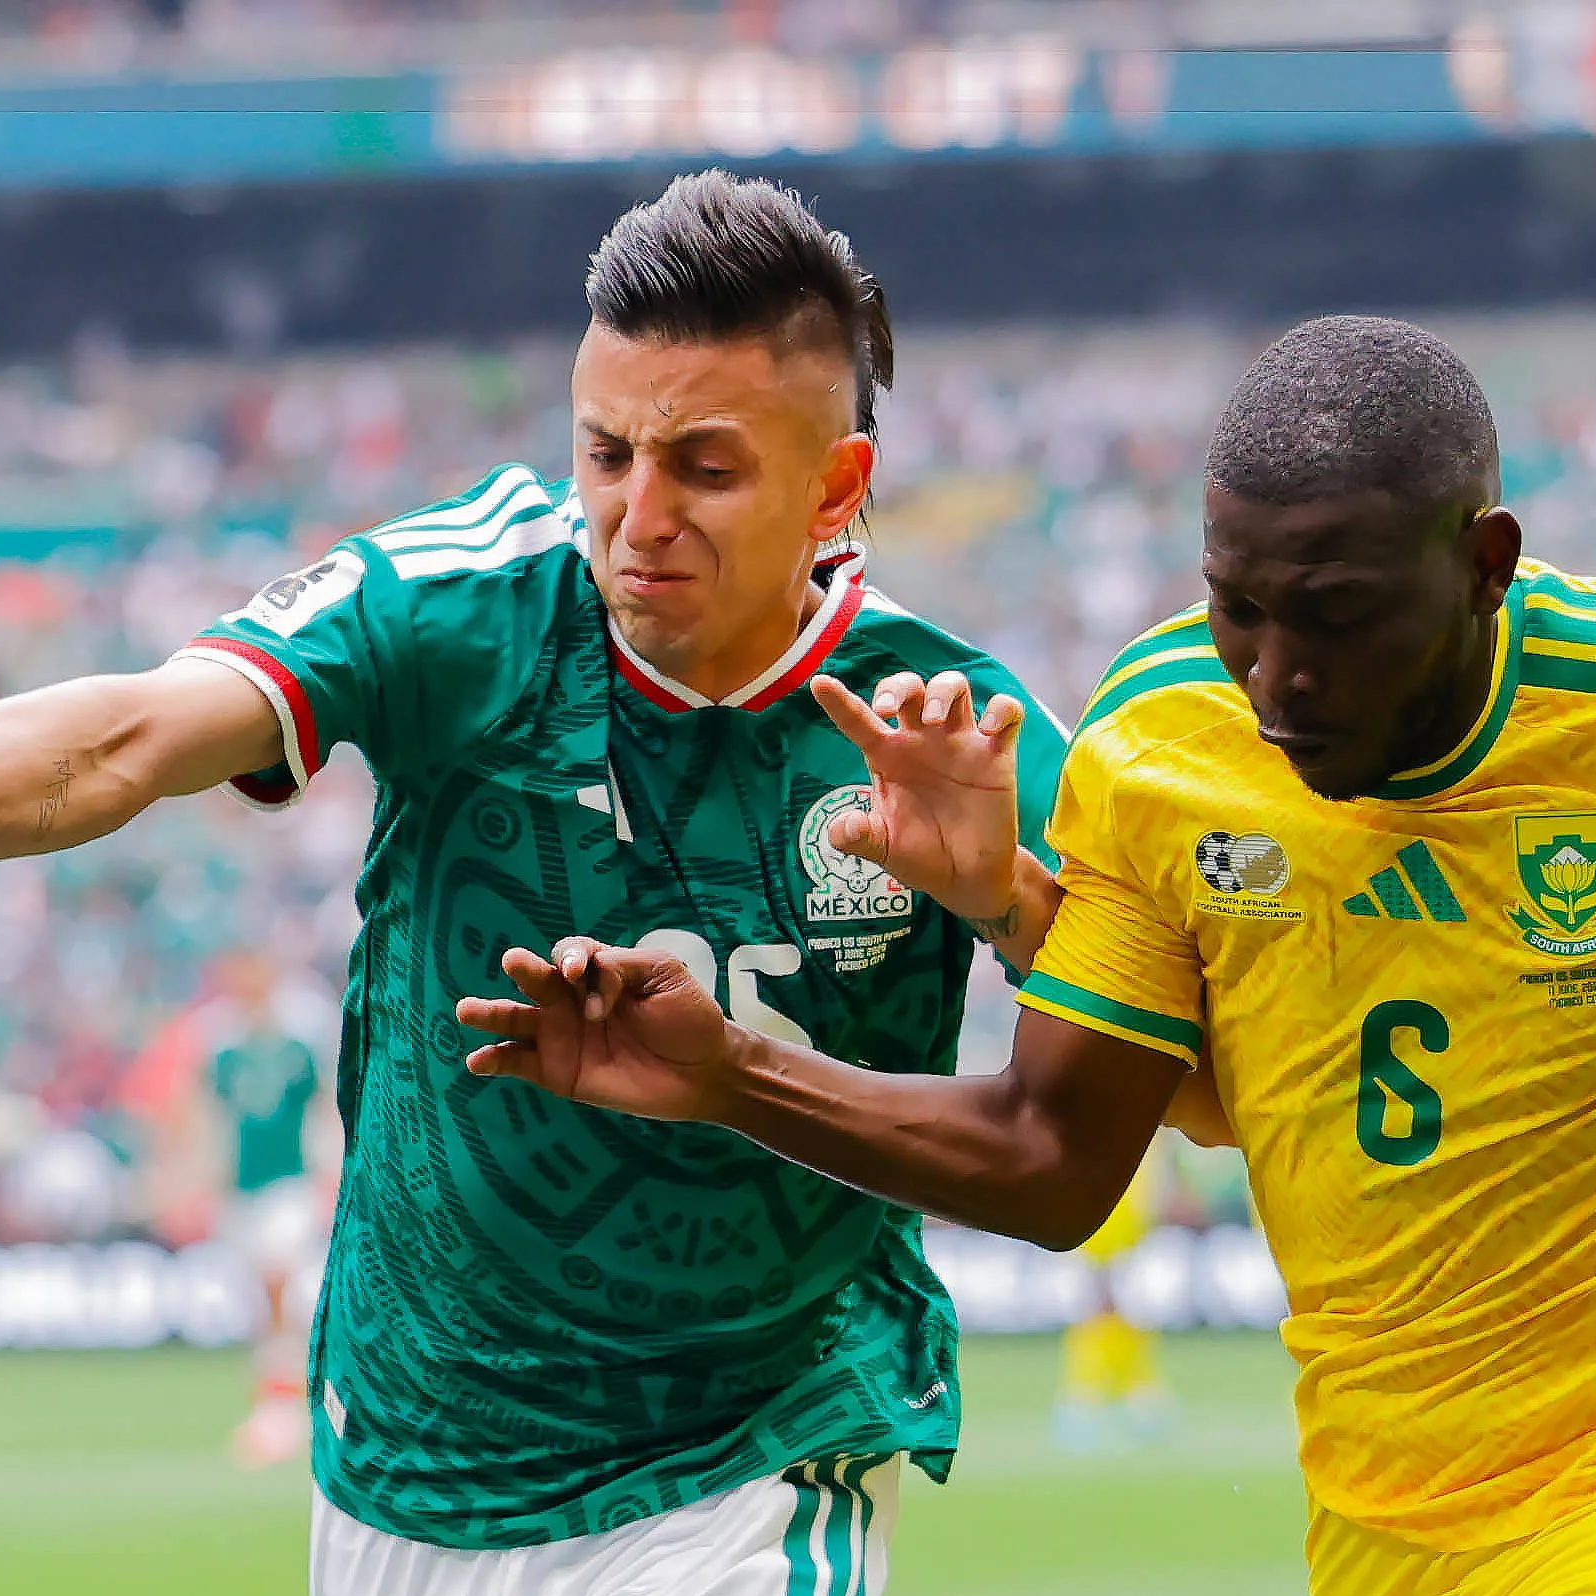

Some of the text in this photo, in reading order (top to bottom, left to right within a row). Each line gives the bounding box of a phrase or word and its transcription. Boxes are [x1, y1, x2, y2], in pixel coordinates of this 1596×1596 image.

[811, 893, 909, 916] MÉXICO
[1210, 895, 1281, 909] SOUTH AFRICAN
[1240, 908, 1302, 920] ASSOCIATION
[1529, 934, 1569, 954] SOUTH
[1356, 999, 1450, 1166] 6
